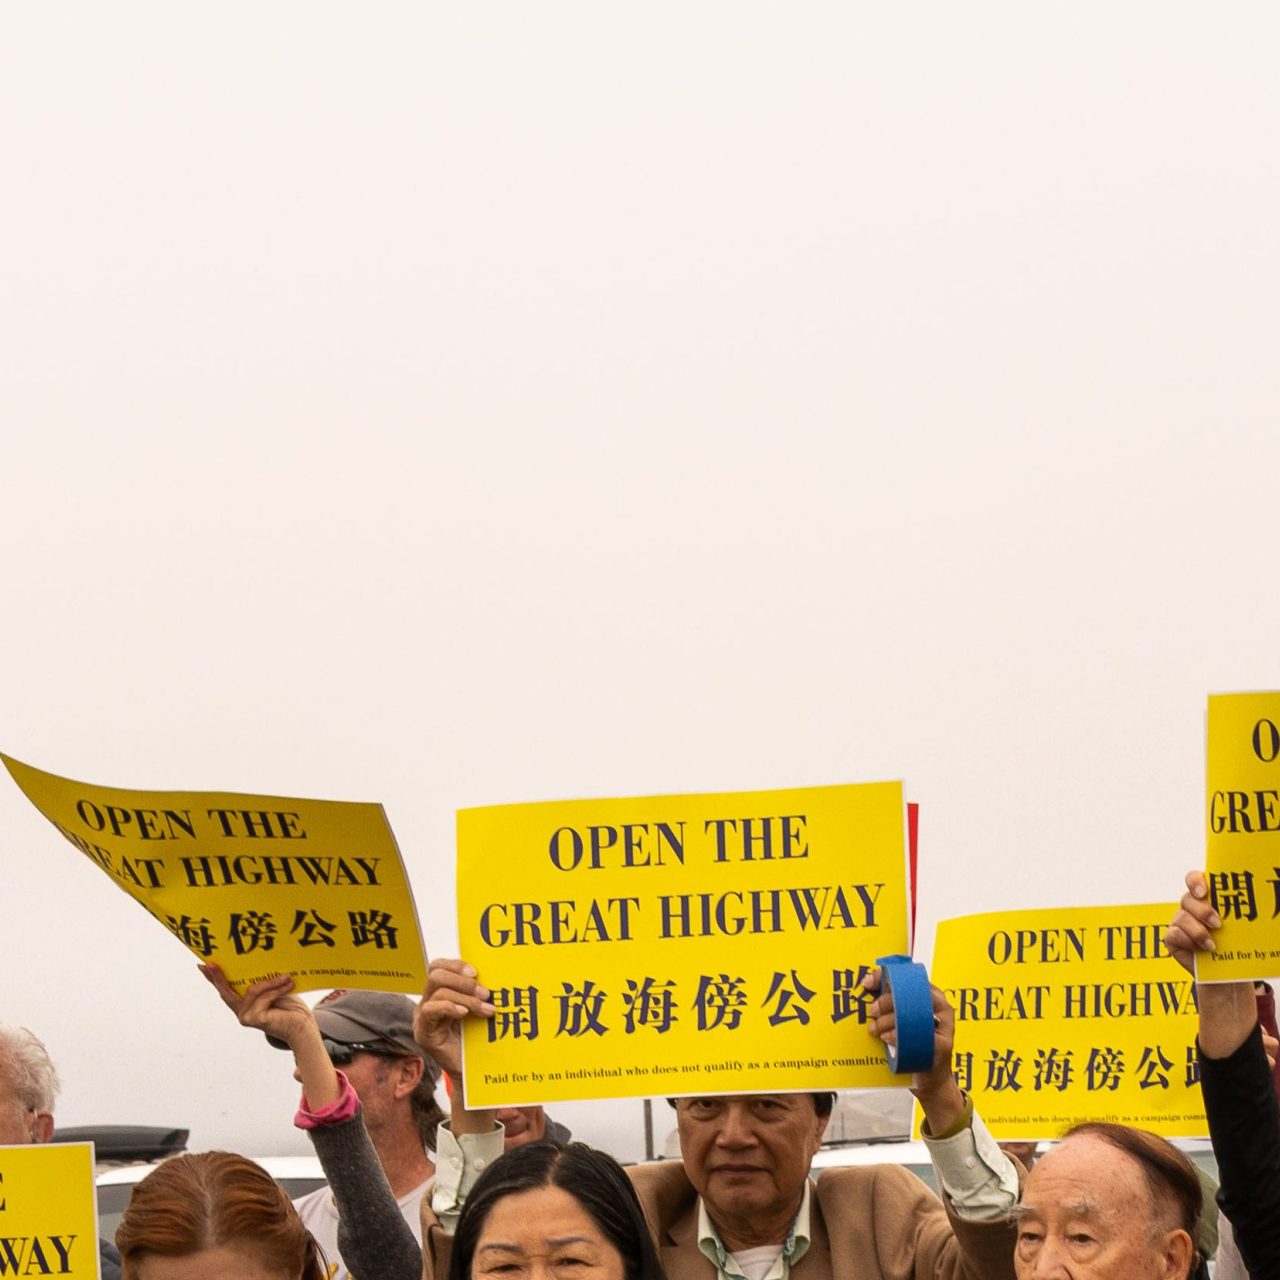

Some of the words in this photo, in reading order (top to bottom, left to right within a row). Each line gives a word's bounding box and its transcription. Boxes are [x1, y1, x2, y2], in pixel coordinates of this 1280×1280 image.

[77, 800, 196, 840] OPEN
[207, 810, 306, 839] THE
[549, 822, 686, 871] OPEN
[705, 815, 808, 862] THE
[181, 856, 379, 886] HIGHWAY
[480, 898, 639, 947] GREAT
[658, 884, 884, 938] HIGHWAY
[988, 928, 1085, 964] OPEN
[1099, 925, 1171, 960] THE
